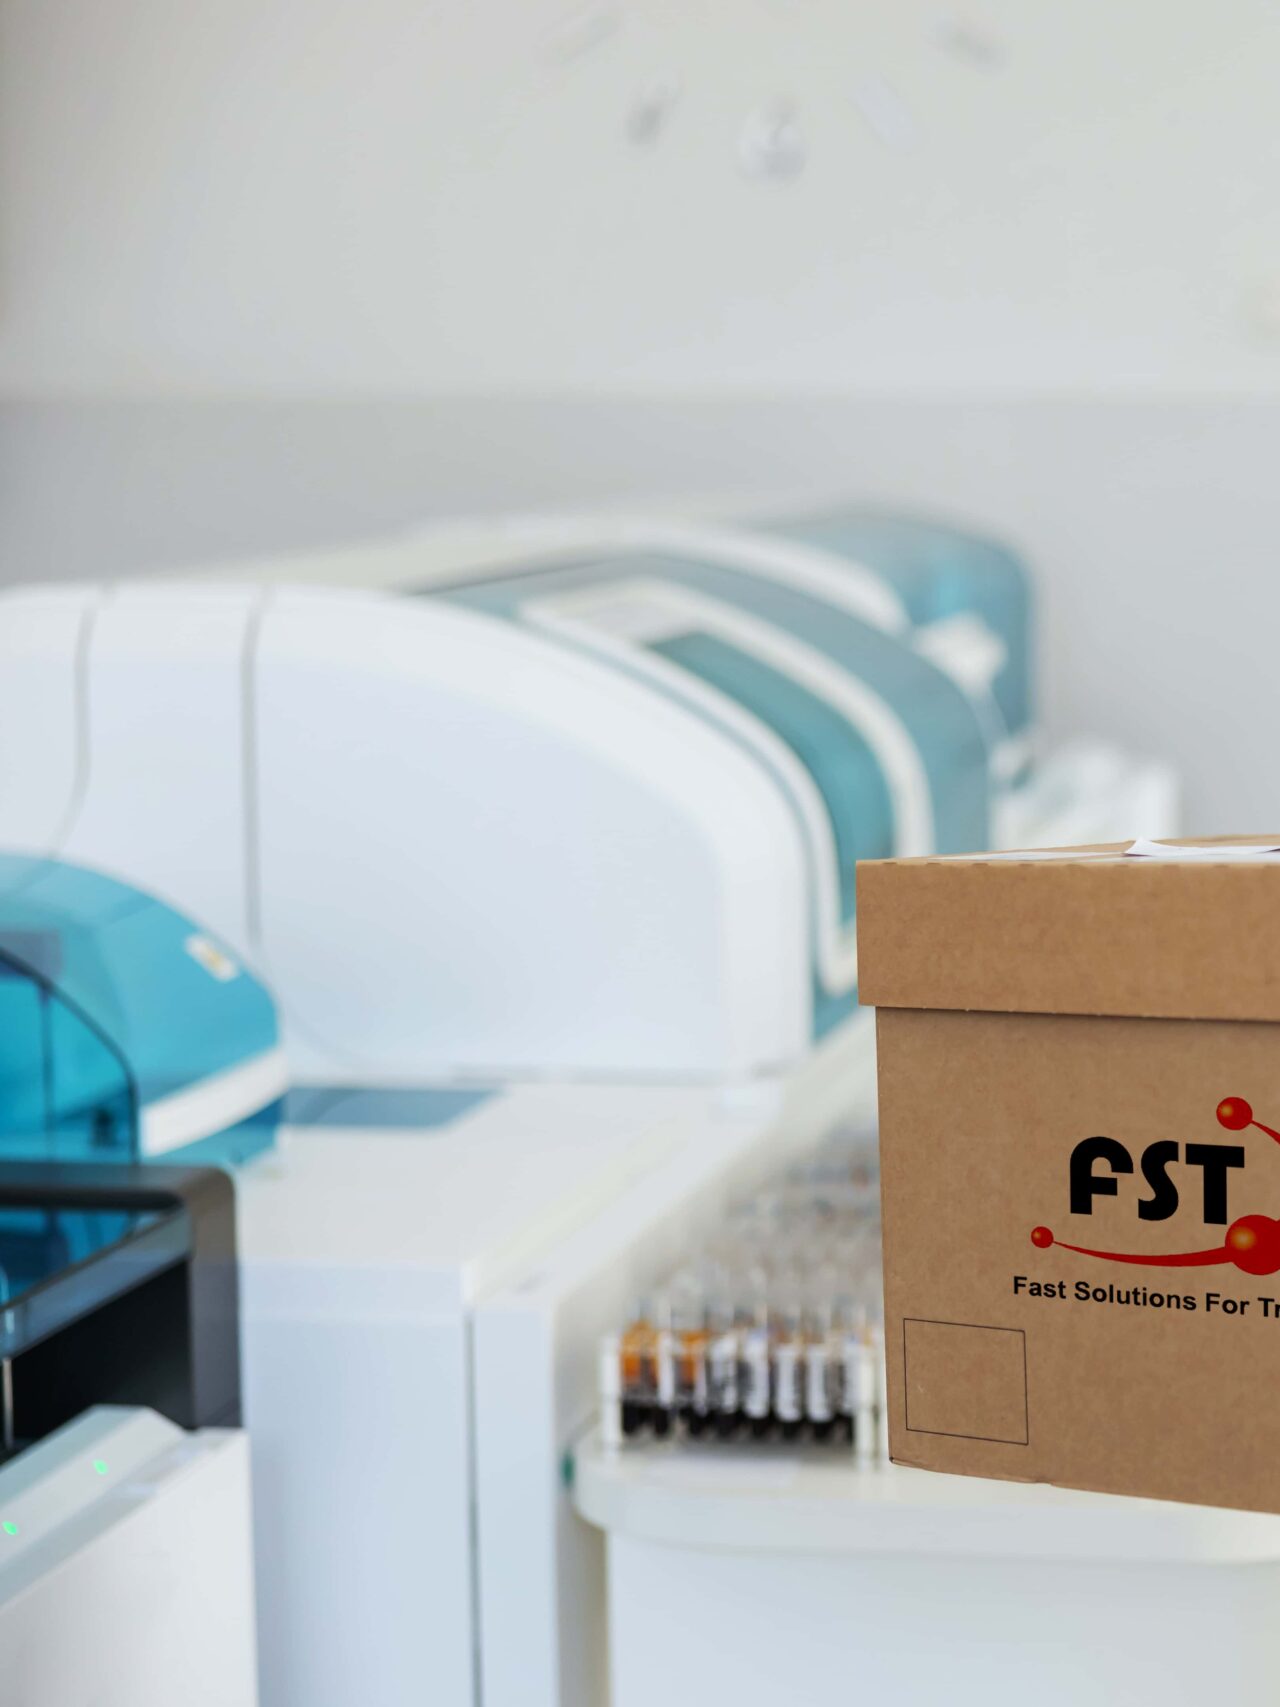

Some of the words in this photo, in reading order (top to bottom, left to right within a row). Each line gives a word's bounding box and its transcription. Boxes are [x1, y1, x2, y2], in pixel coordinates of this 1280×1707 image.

[1069, 1136, 1245, 1226] FST
[1013, 1275, 1067, 1300] Fast
[1074, 1281, 1197, 1311] Solutions
[1205, 1292, 1250, 1315] For
